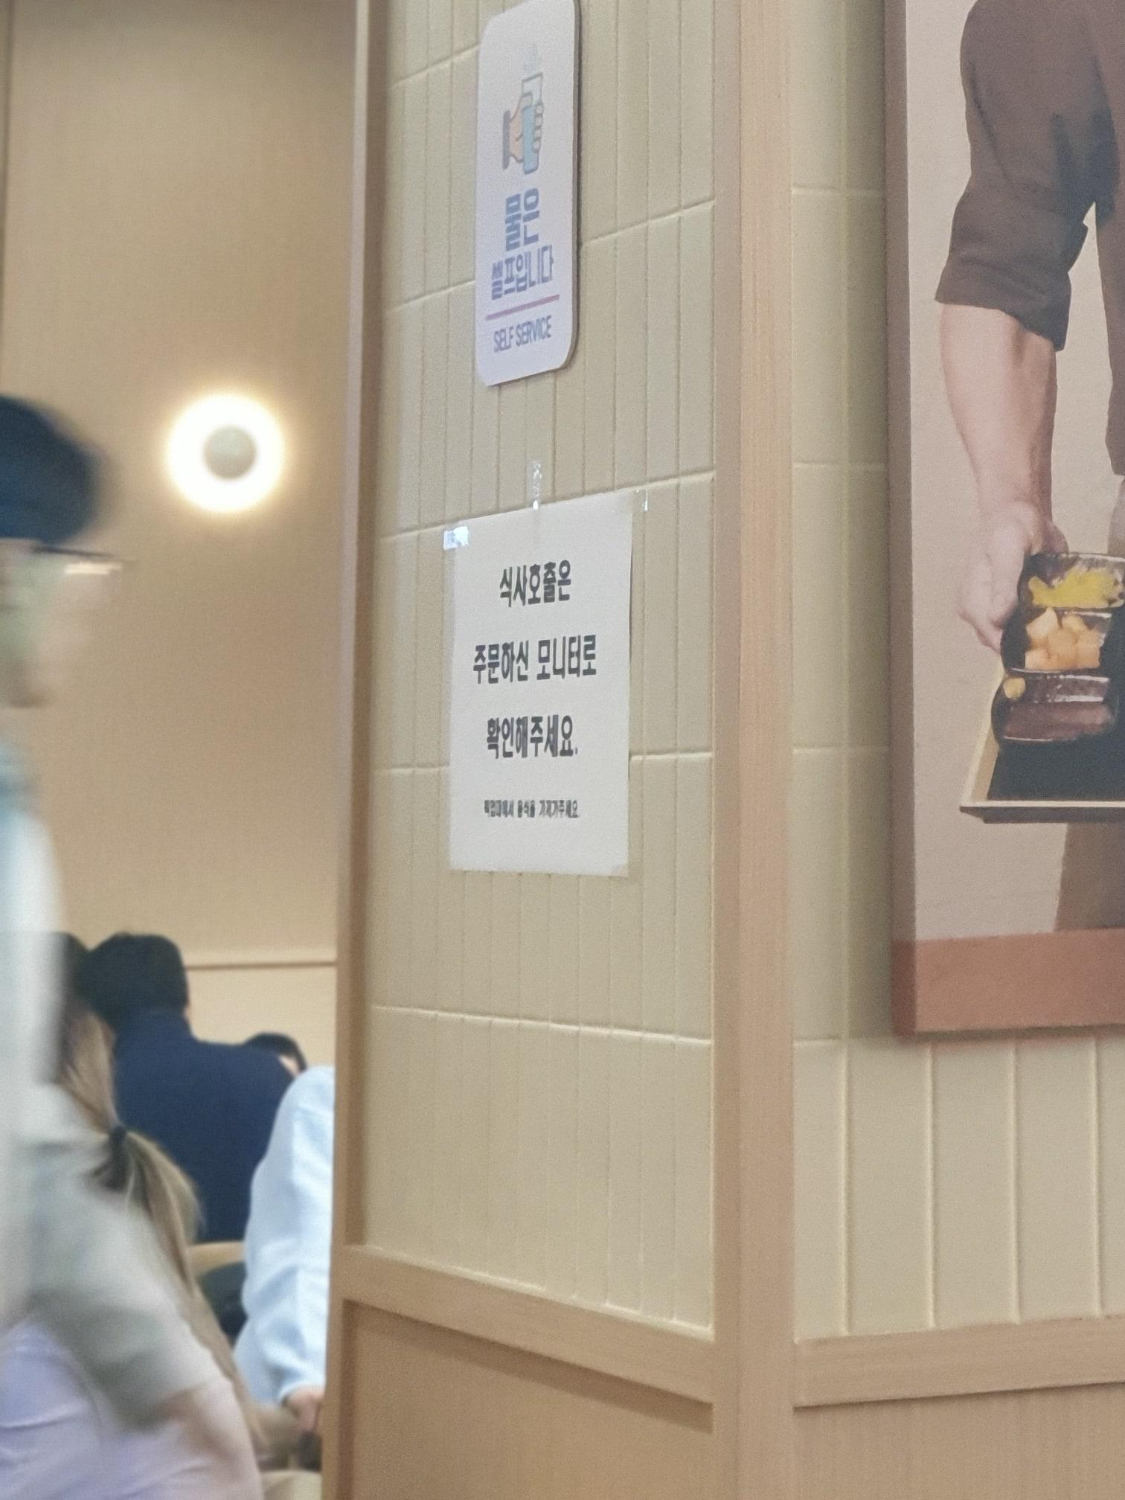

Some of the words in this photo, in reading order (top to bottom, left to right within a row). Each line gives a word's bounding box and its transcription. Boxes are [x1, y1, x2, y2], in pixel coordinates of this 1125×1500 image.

[504, 187, 540, 252] 물은
[491, 244, 554, 301] 셀프입니다
[493, 326, 514, 353] SELF
[515, 314, 552, 347] SERVICE
[499, 559, 571, 607] 식사호출은
[473, 640, 529, 684] 주문하신
[536, 634, 596, 680] 모니터로
[486, 714, 578, 760] 확인해주세요.
